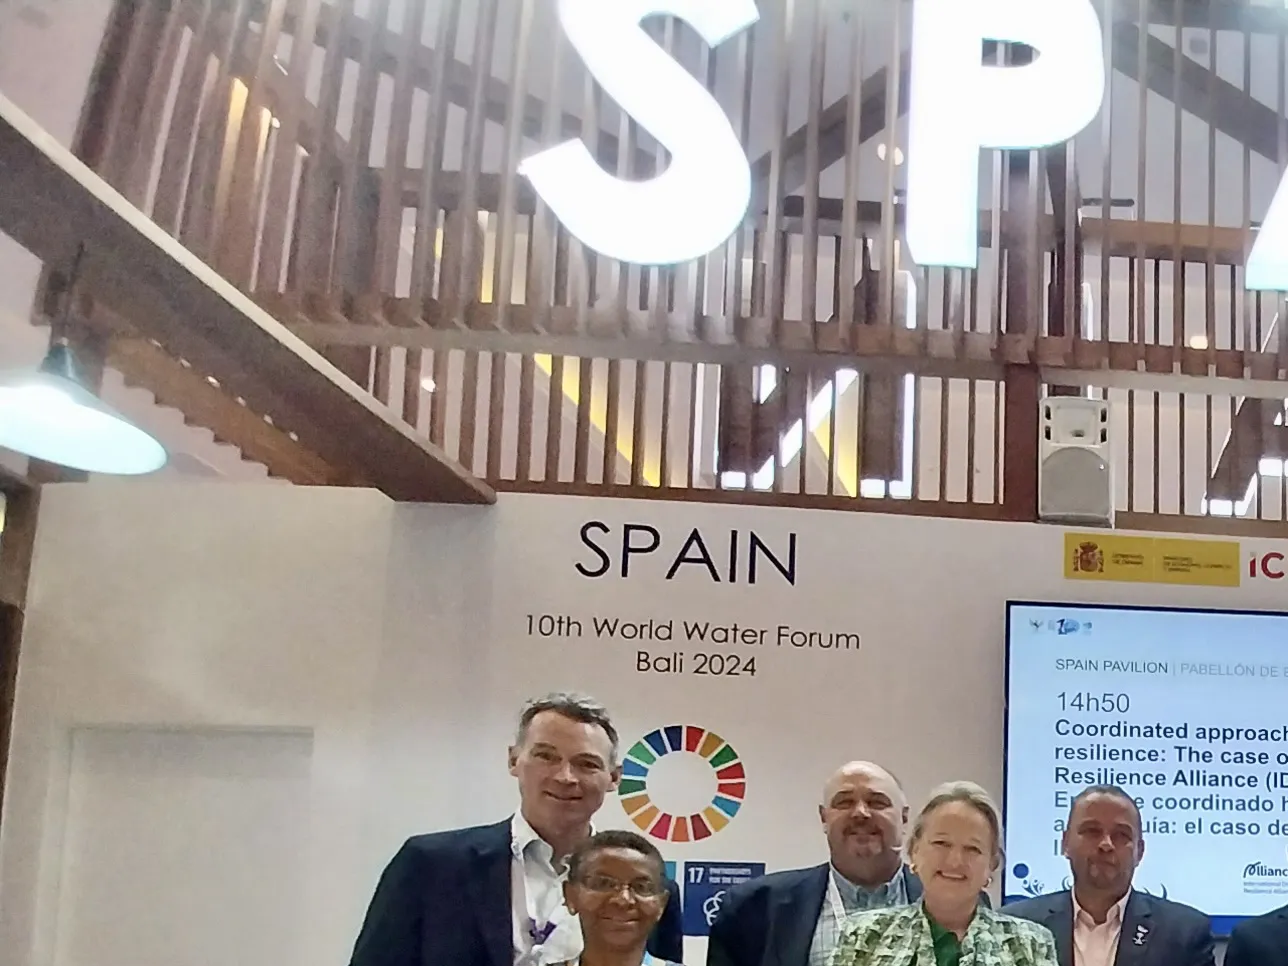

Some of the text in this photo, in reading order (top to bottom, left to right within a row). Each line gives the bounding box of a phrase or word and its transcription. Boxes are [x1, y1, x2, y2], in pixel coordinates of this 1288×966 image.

[574, 520, 798, 587] SPAIN
[526, 614, 860, 649] 10th World Water Forum
[636, 650, 757, 676] Bali 2024
[1055, 658, 1099, 672] SPAIN
[1103, 660, 1168, 675] PAVILION
[1180, 661, 1255, 678] PABELLÓN
[1259, 666, 1279, 678] DE
[1057, 691, 1131, 713] 14h50
[1055, 718, 1188, 739] Coordinated
[1055, 744, 1166, 763] resilience:
[1174, 746, 1213, 763] The
[1220, 751, 1269, 765] case
[1055, 766, 1167, 786] Resilience
[1172, 769, 1258, 788] Alliance
[1152, 792, 1274, 812] coordinado
[1054, 819, 1065, 832] a
[1184, 817, 1202, 834] el
[1210, 821, 1261, 836] caso
[688, 867, 704, 884] 17
